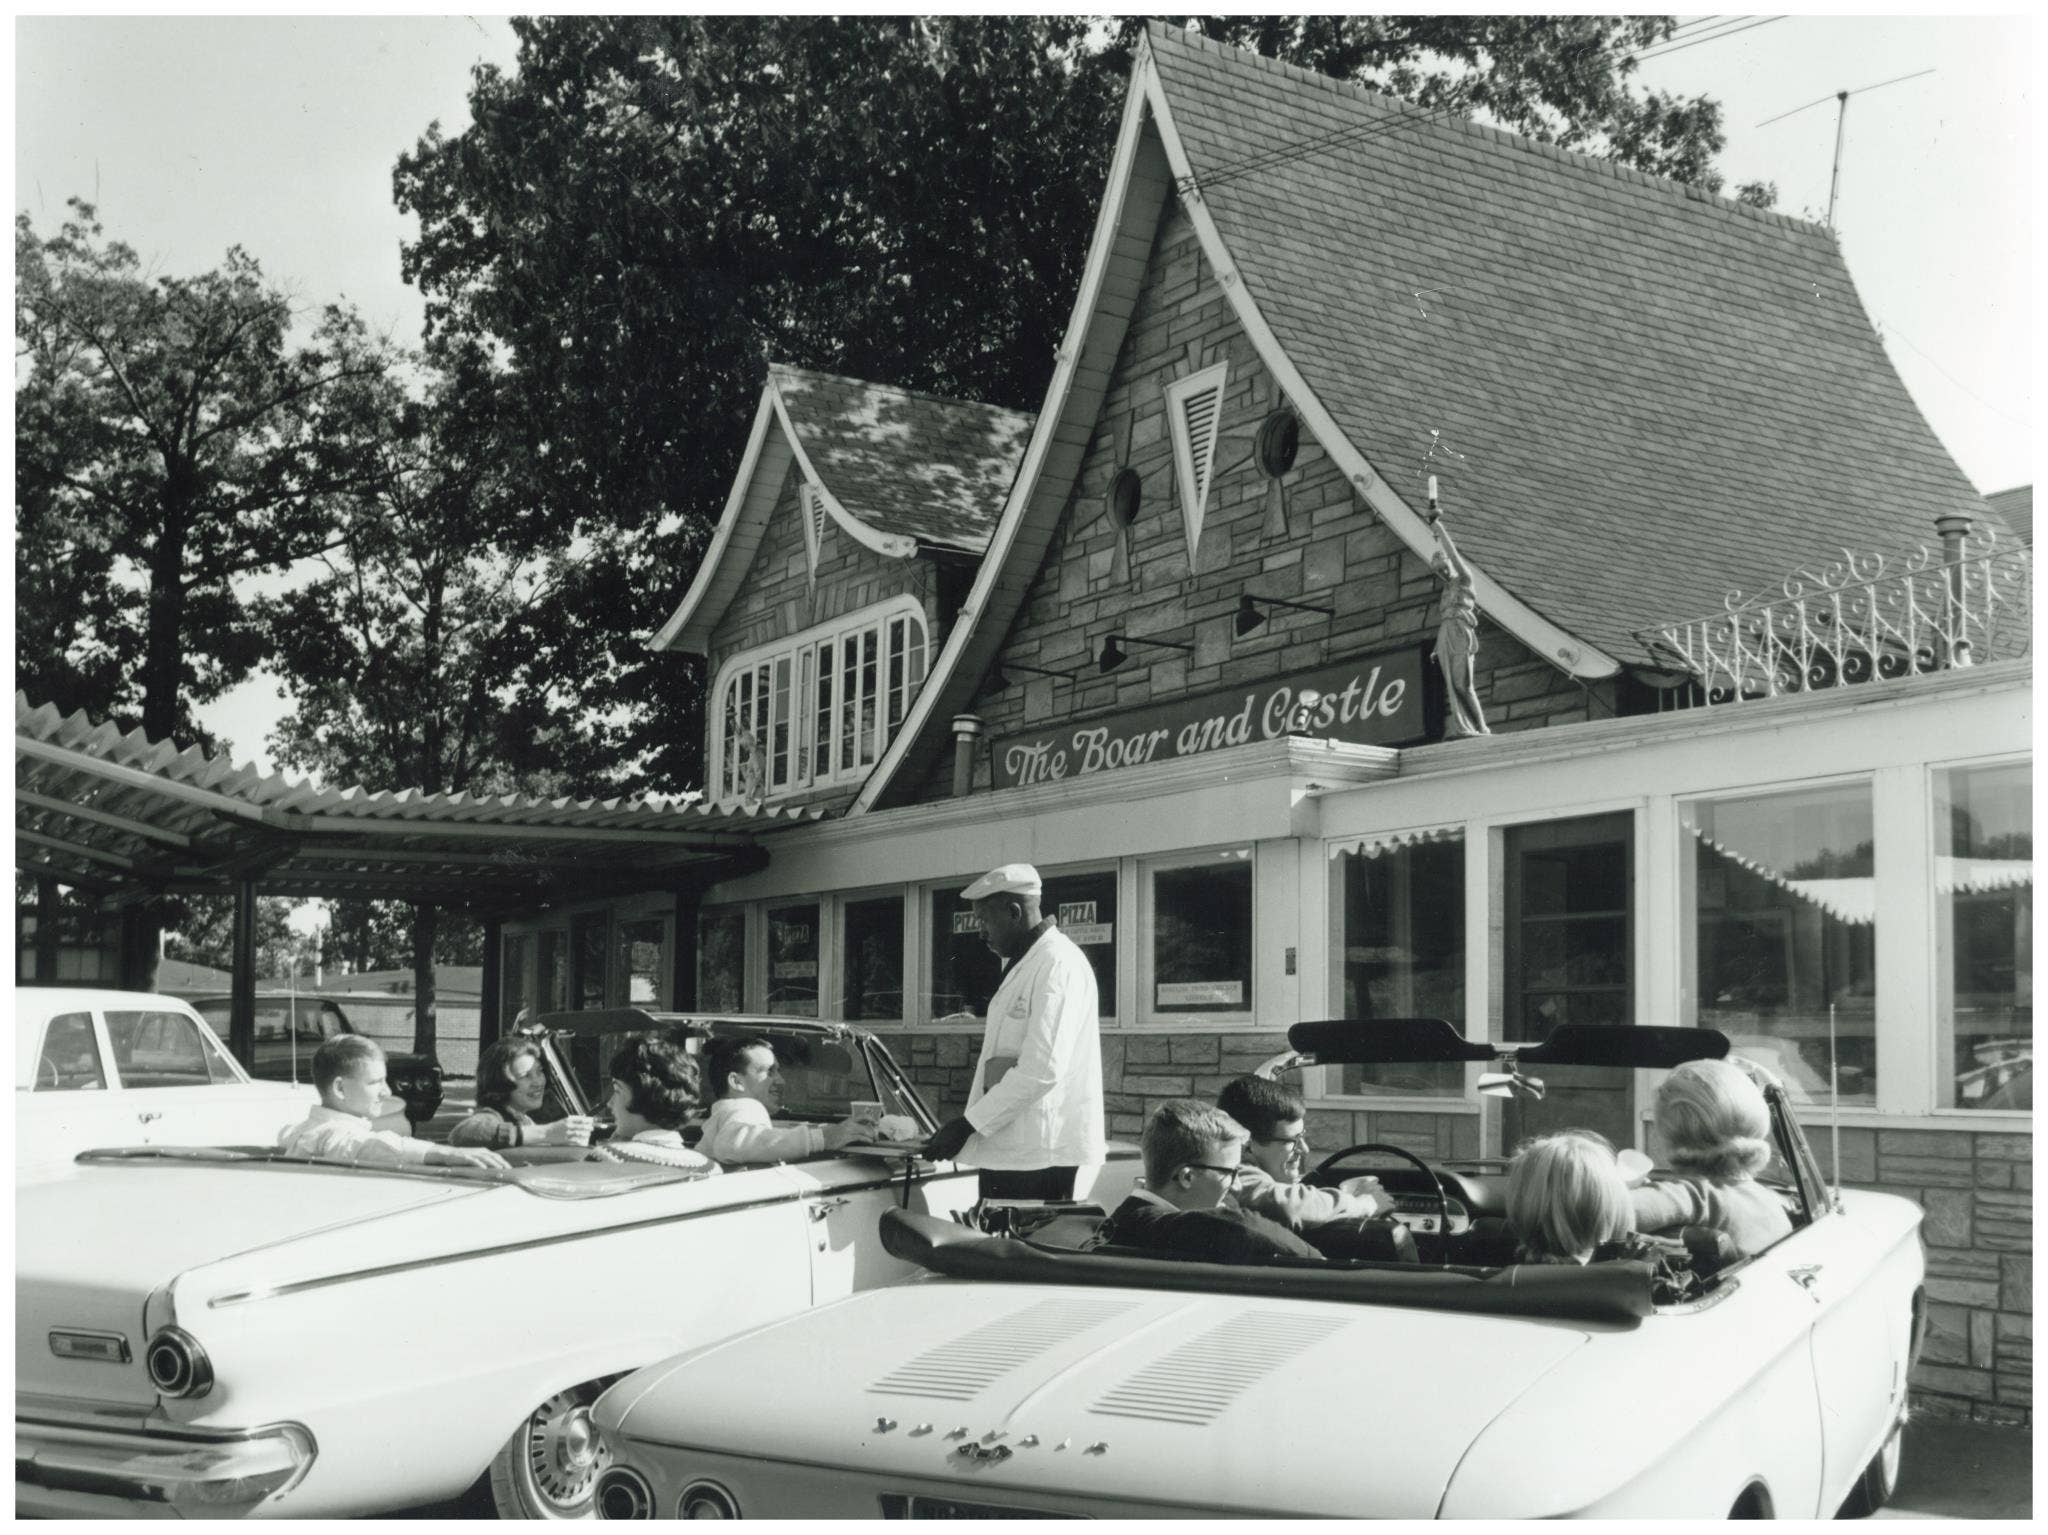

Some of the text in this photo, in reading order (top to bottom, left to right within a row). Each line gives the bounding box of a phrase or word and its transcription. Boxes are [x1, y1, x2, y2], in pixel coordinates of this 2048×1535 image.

[1006, 740, 1067, 785] The
[1072, 726, 1168, 774] Boar
[1177, 696, 1253, 754] and
[954, 914, 980, 932] PIZZ
[1061, 903, 1095, 925] PIZZA
